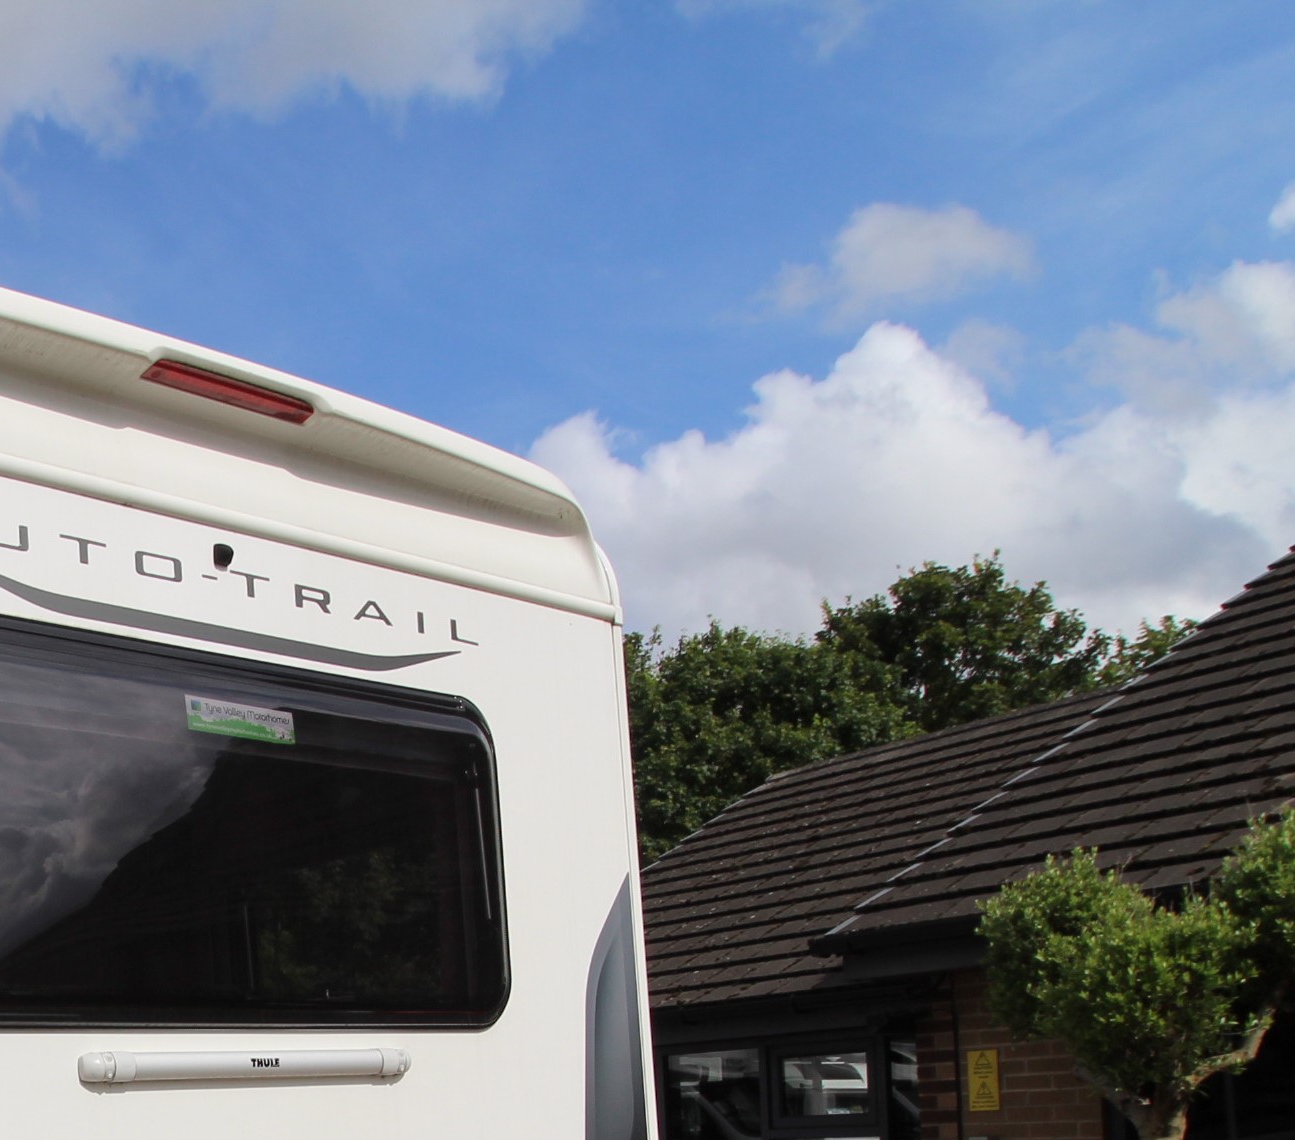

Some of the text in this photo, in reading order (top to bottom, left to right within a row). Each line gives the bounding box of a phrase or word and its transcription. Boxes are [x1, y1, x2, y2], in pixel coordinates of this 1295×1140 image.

[204, 702, 290, 725] Tyne Valley Motorhomes
[250, 1057, 281, 1068] THULE
